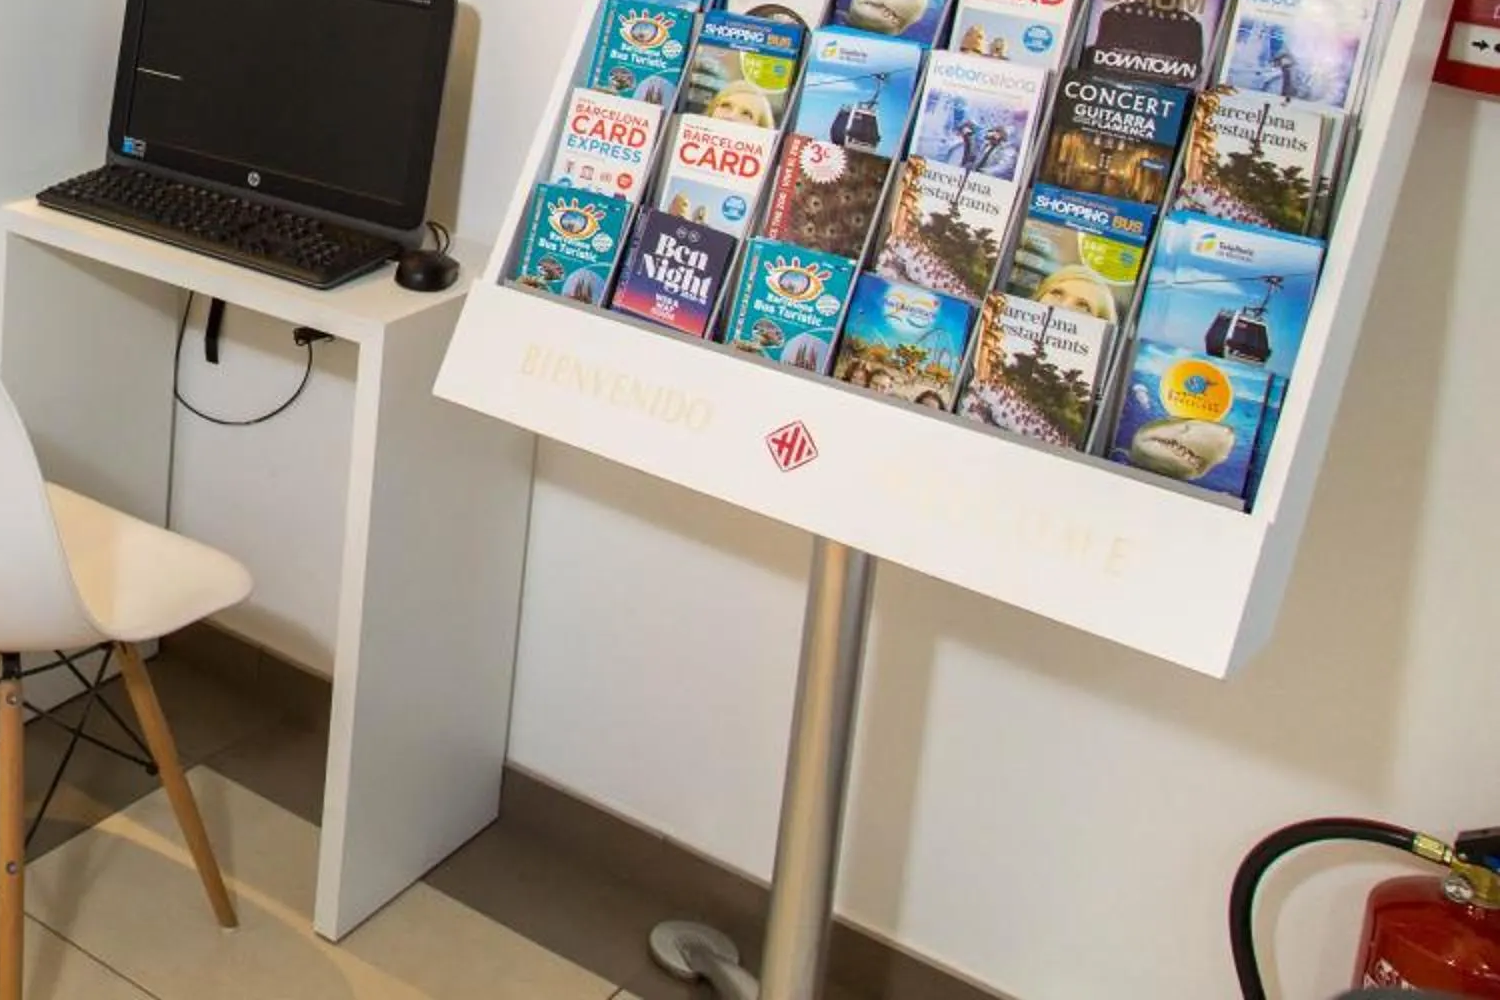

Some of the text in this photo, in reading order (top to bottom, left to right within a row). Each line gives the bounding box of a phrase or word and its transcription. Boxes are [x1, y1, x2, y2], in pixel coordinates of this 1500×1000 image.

[704, 23, 765, 44] SHOPPING
[610, 49, 630, 61] Bus
[1093, 49, 1198, 79] DOWNTOWN
[1064, 80, 1176, 119] CONCERT
[575, 103, 650, 128] BARCELONA
[1074, 103, 1157, 131] GUITARRA
[1090, 117, 1154, 139] FLAMENCA
[1217, 102, 1296, 131] arcelona
[571, 115, 647, 148] CARD
[683, 127, 763, 156] BARCELONA
[1214, 121, 1309, 152] estaurants
[566, 133, 642, 163] EXPRESS
[679, 141, 761, 178] CARD
[921, 166, 994, 198] arcelona
[917, 184, 1001, 217] estaurants
[1035, 195, 1109, 225] SHOPPING
[1112, 214, 1144, 234] BUS
[538, 237, 558, 251] Bus
[656, 233, 709, 271] Bcn
[644, 253, 713, 299] Night
[753, 299, 775, 314] Bus
[1003, 305, 1078, 335] arcelona
[1002, 322, 1089, 355] estaurants
